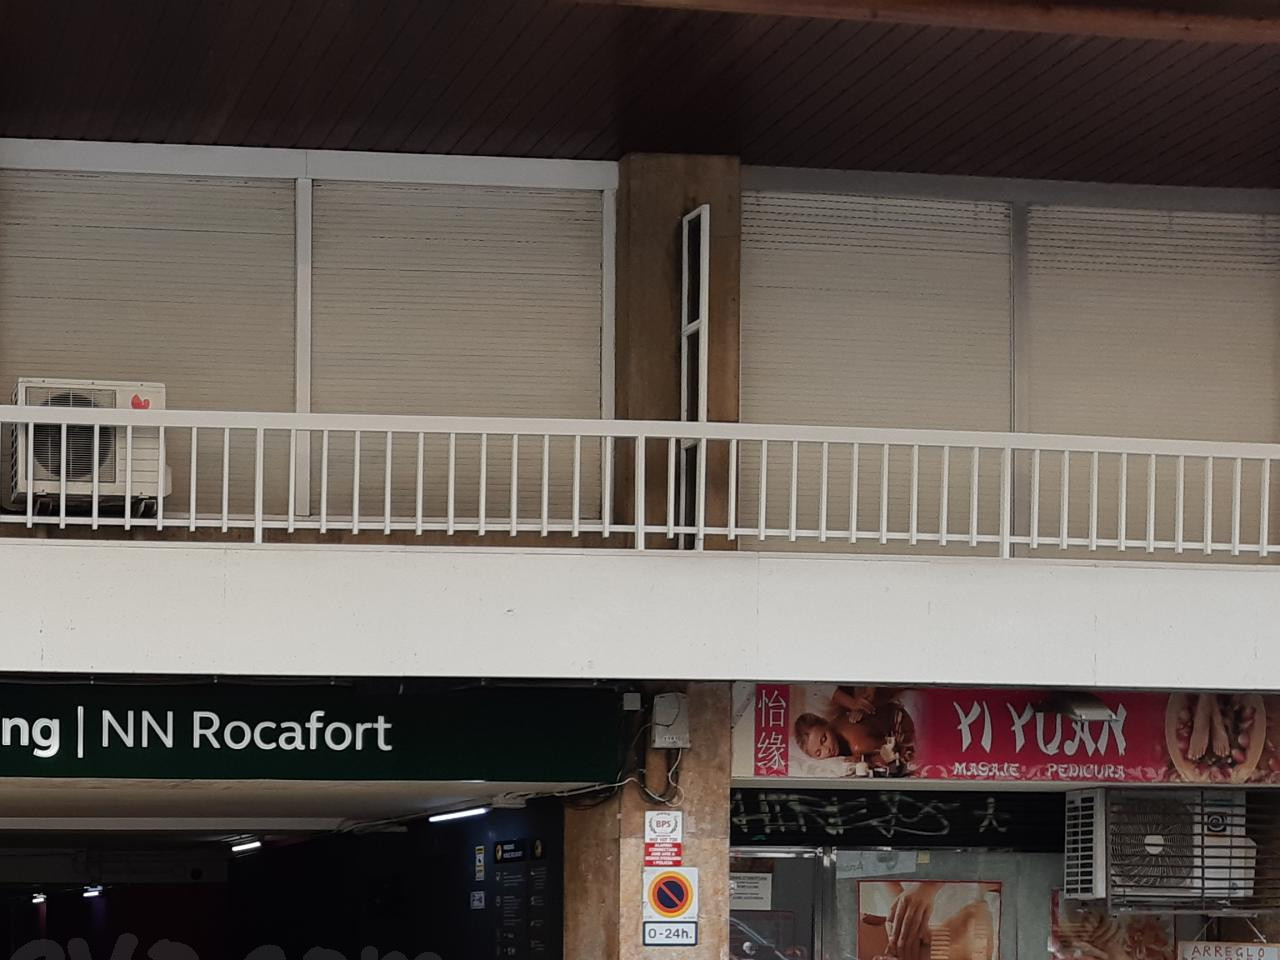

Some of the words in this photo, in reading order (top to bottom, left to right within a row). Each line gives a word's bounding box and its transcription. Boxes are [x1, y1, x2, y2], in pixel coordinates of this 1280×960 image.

[101, 710, 174, 749] NN
[192, 710, 393, 751] Rocafort
[953, 701, 993, 754] YI
[1006, 702, 1128, 758] YUAN
[953, 762, 1020, 777] MASAJE
[1047, 763, 1126, 778] PEDICURA
[655, 820, 672, 828] BPS
[1191, 945, 1265, 958] ARREGLO
